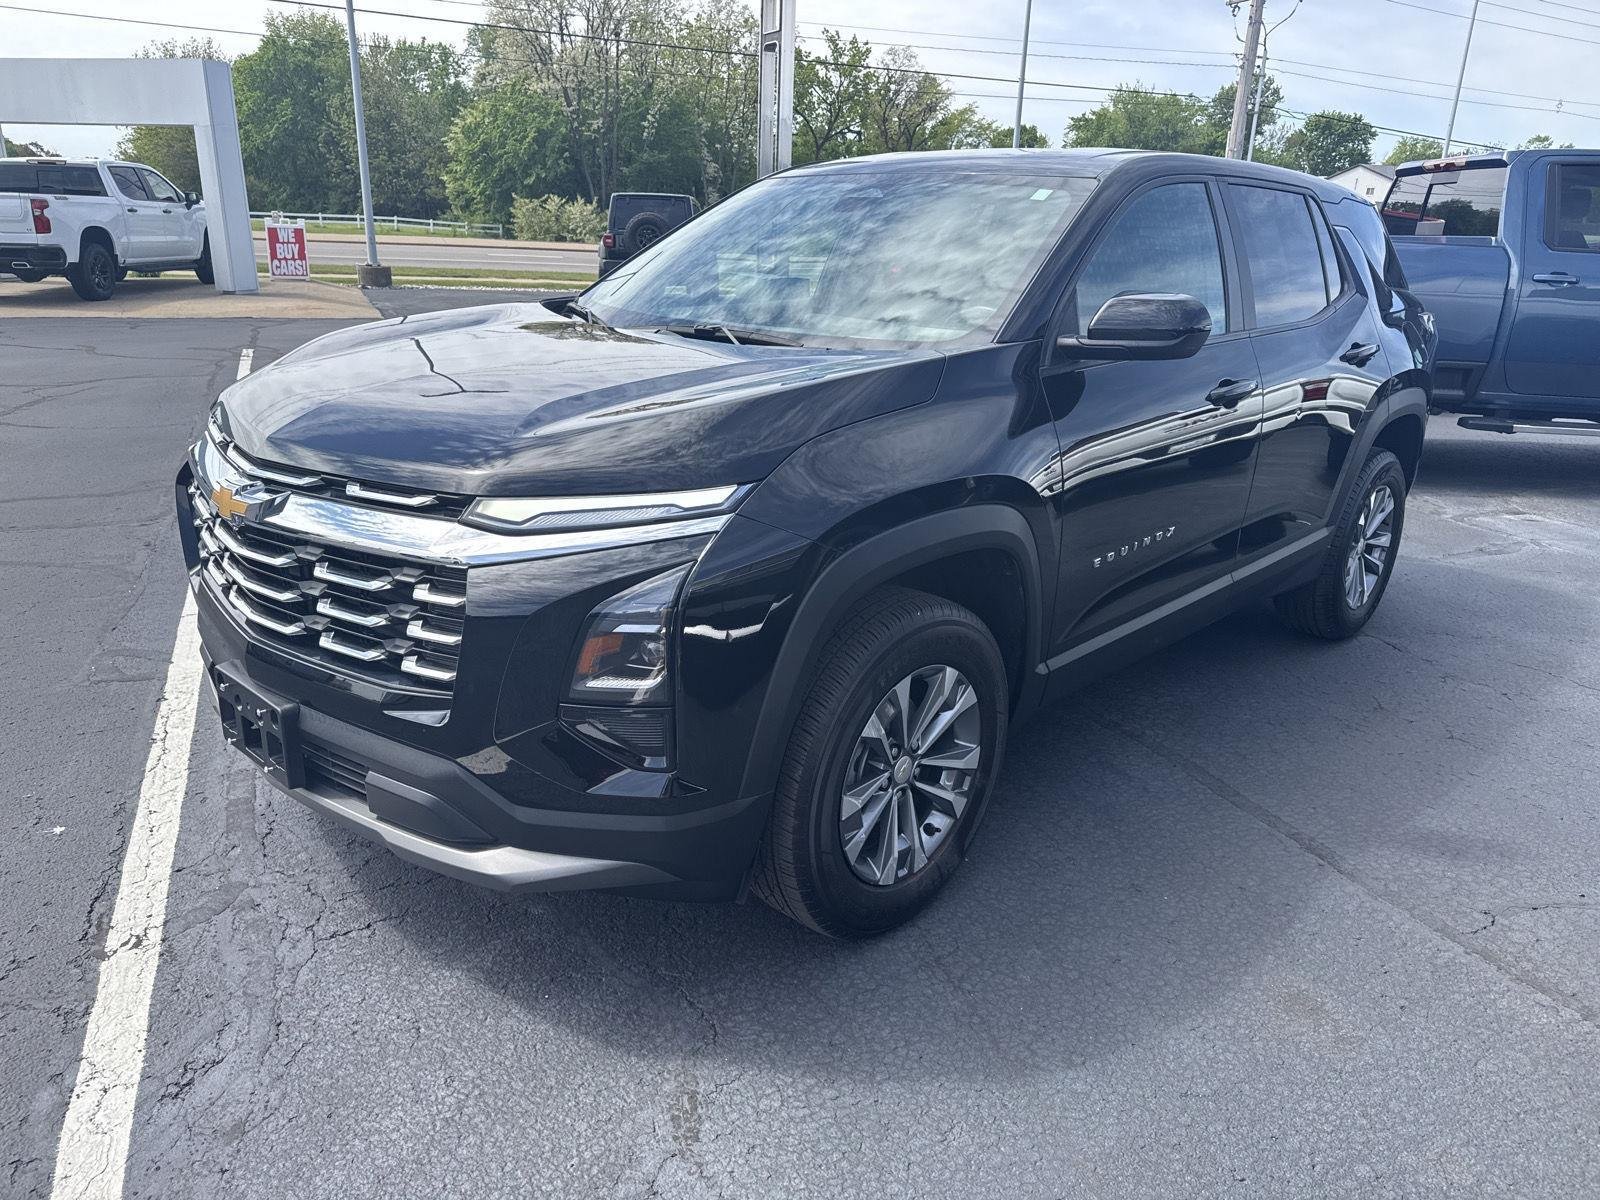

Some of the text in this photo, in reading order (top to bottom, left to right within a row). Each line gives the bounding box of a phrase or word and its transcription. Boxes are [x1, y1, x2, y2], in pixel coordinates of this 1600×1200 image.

[277, 228, 296, 242] WE
[276, 243, 299, 259] BUY
[272, 259, 307, 276] CARS!
[1093, 526, 1175, 568] EQUINOX
